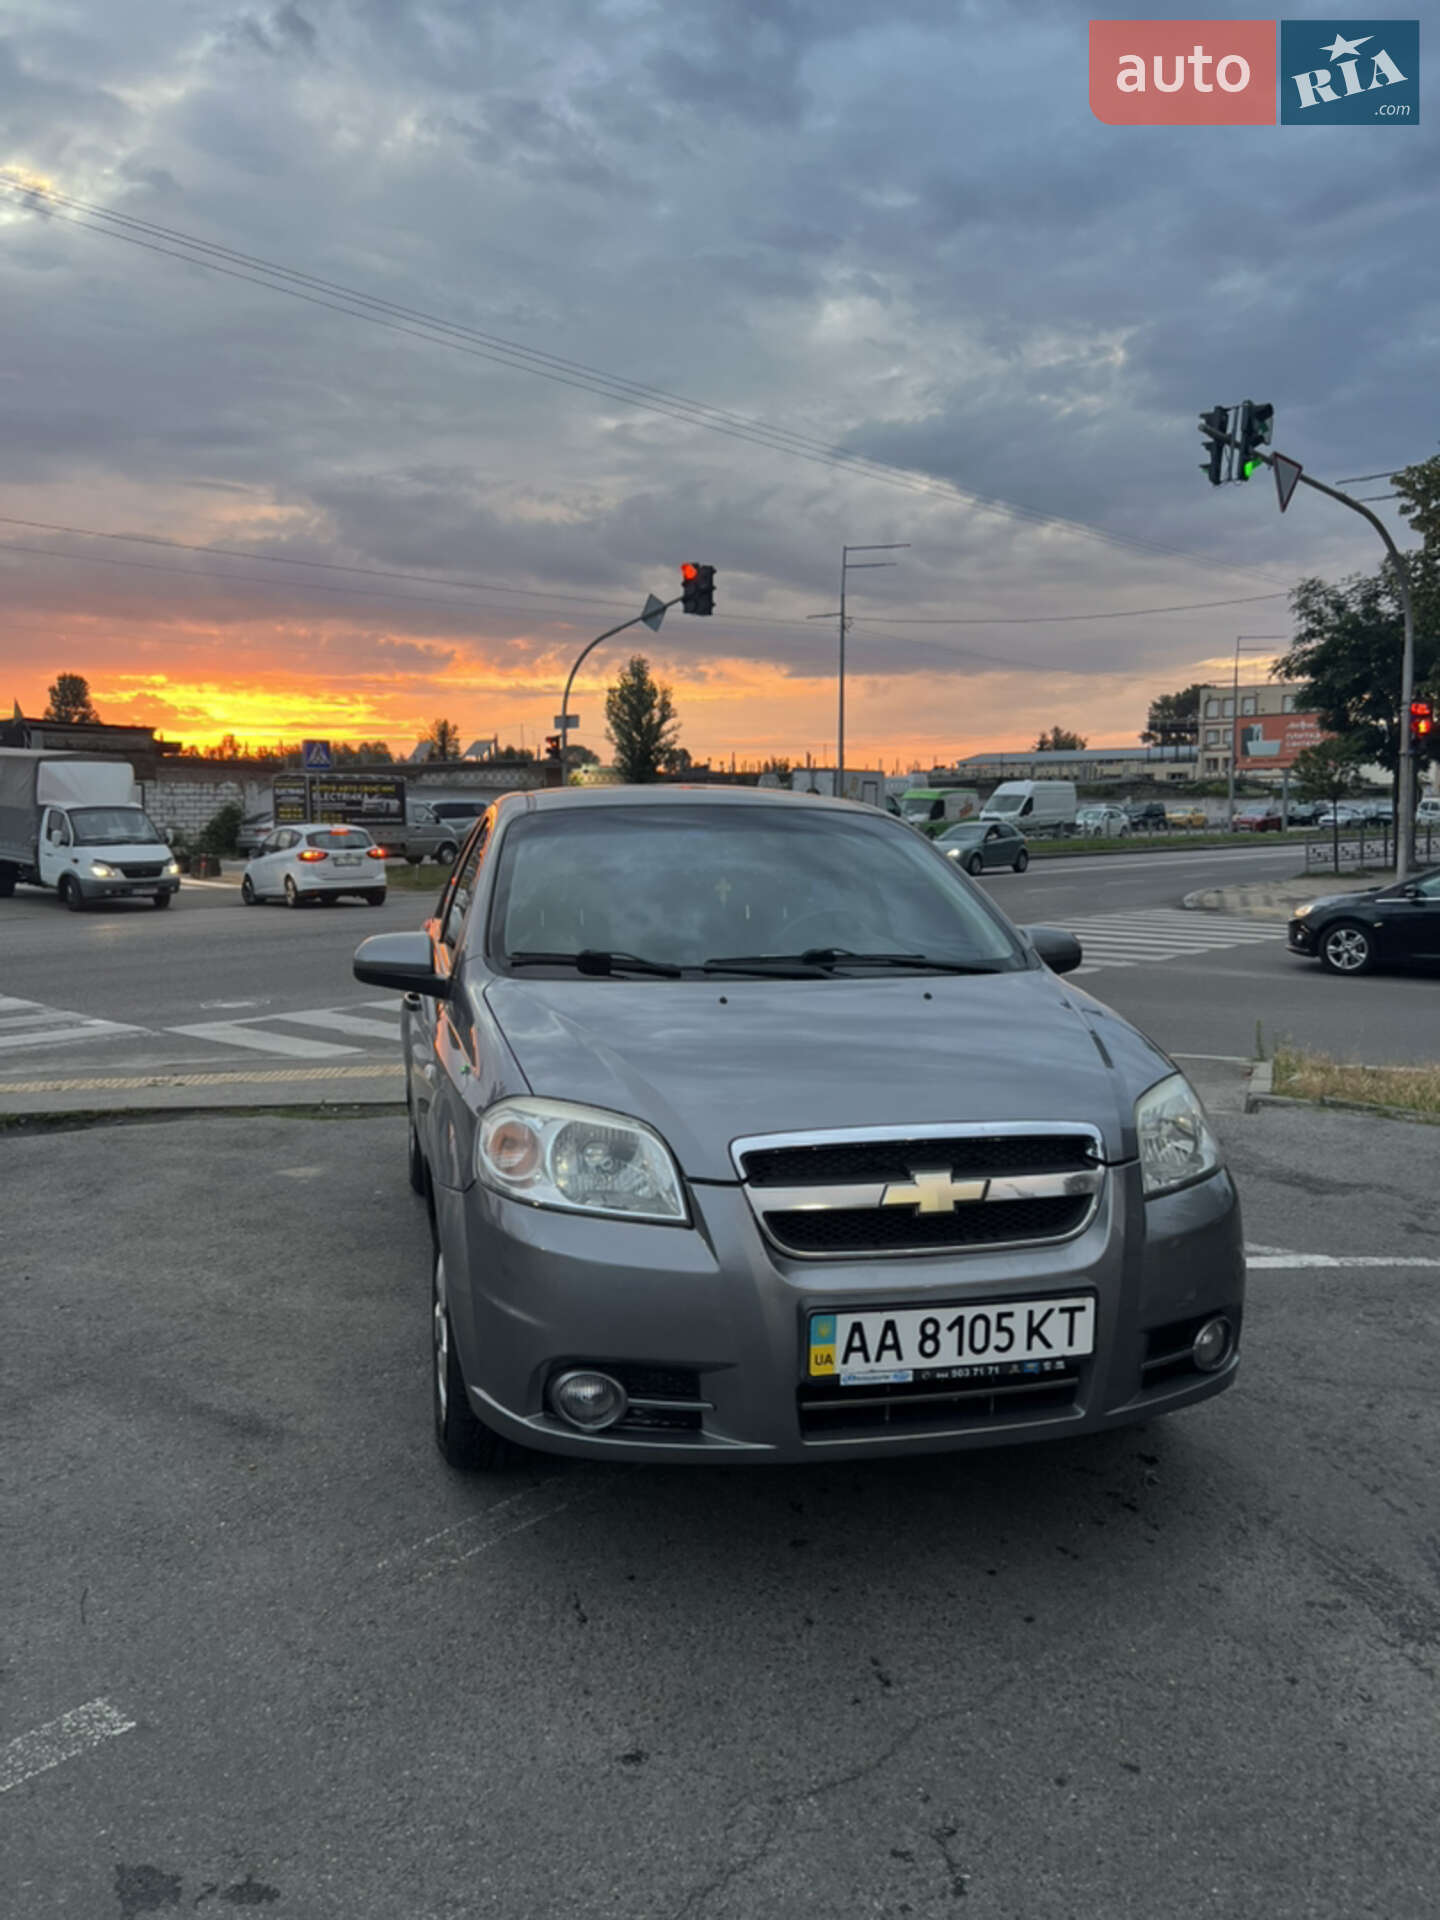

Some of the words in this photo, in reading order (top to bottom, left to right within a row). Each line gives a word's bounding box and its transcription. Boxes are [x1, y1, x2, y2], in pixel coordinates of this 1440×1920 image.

[841, 1319, 904, 1365] AA
[917, 1311, 1014, 1359] 8105
[1026, 1305, 1086, 1351] KT
[814, 1353, 834, 1366] UA
